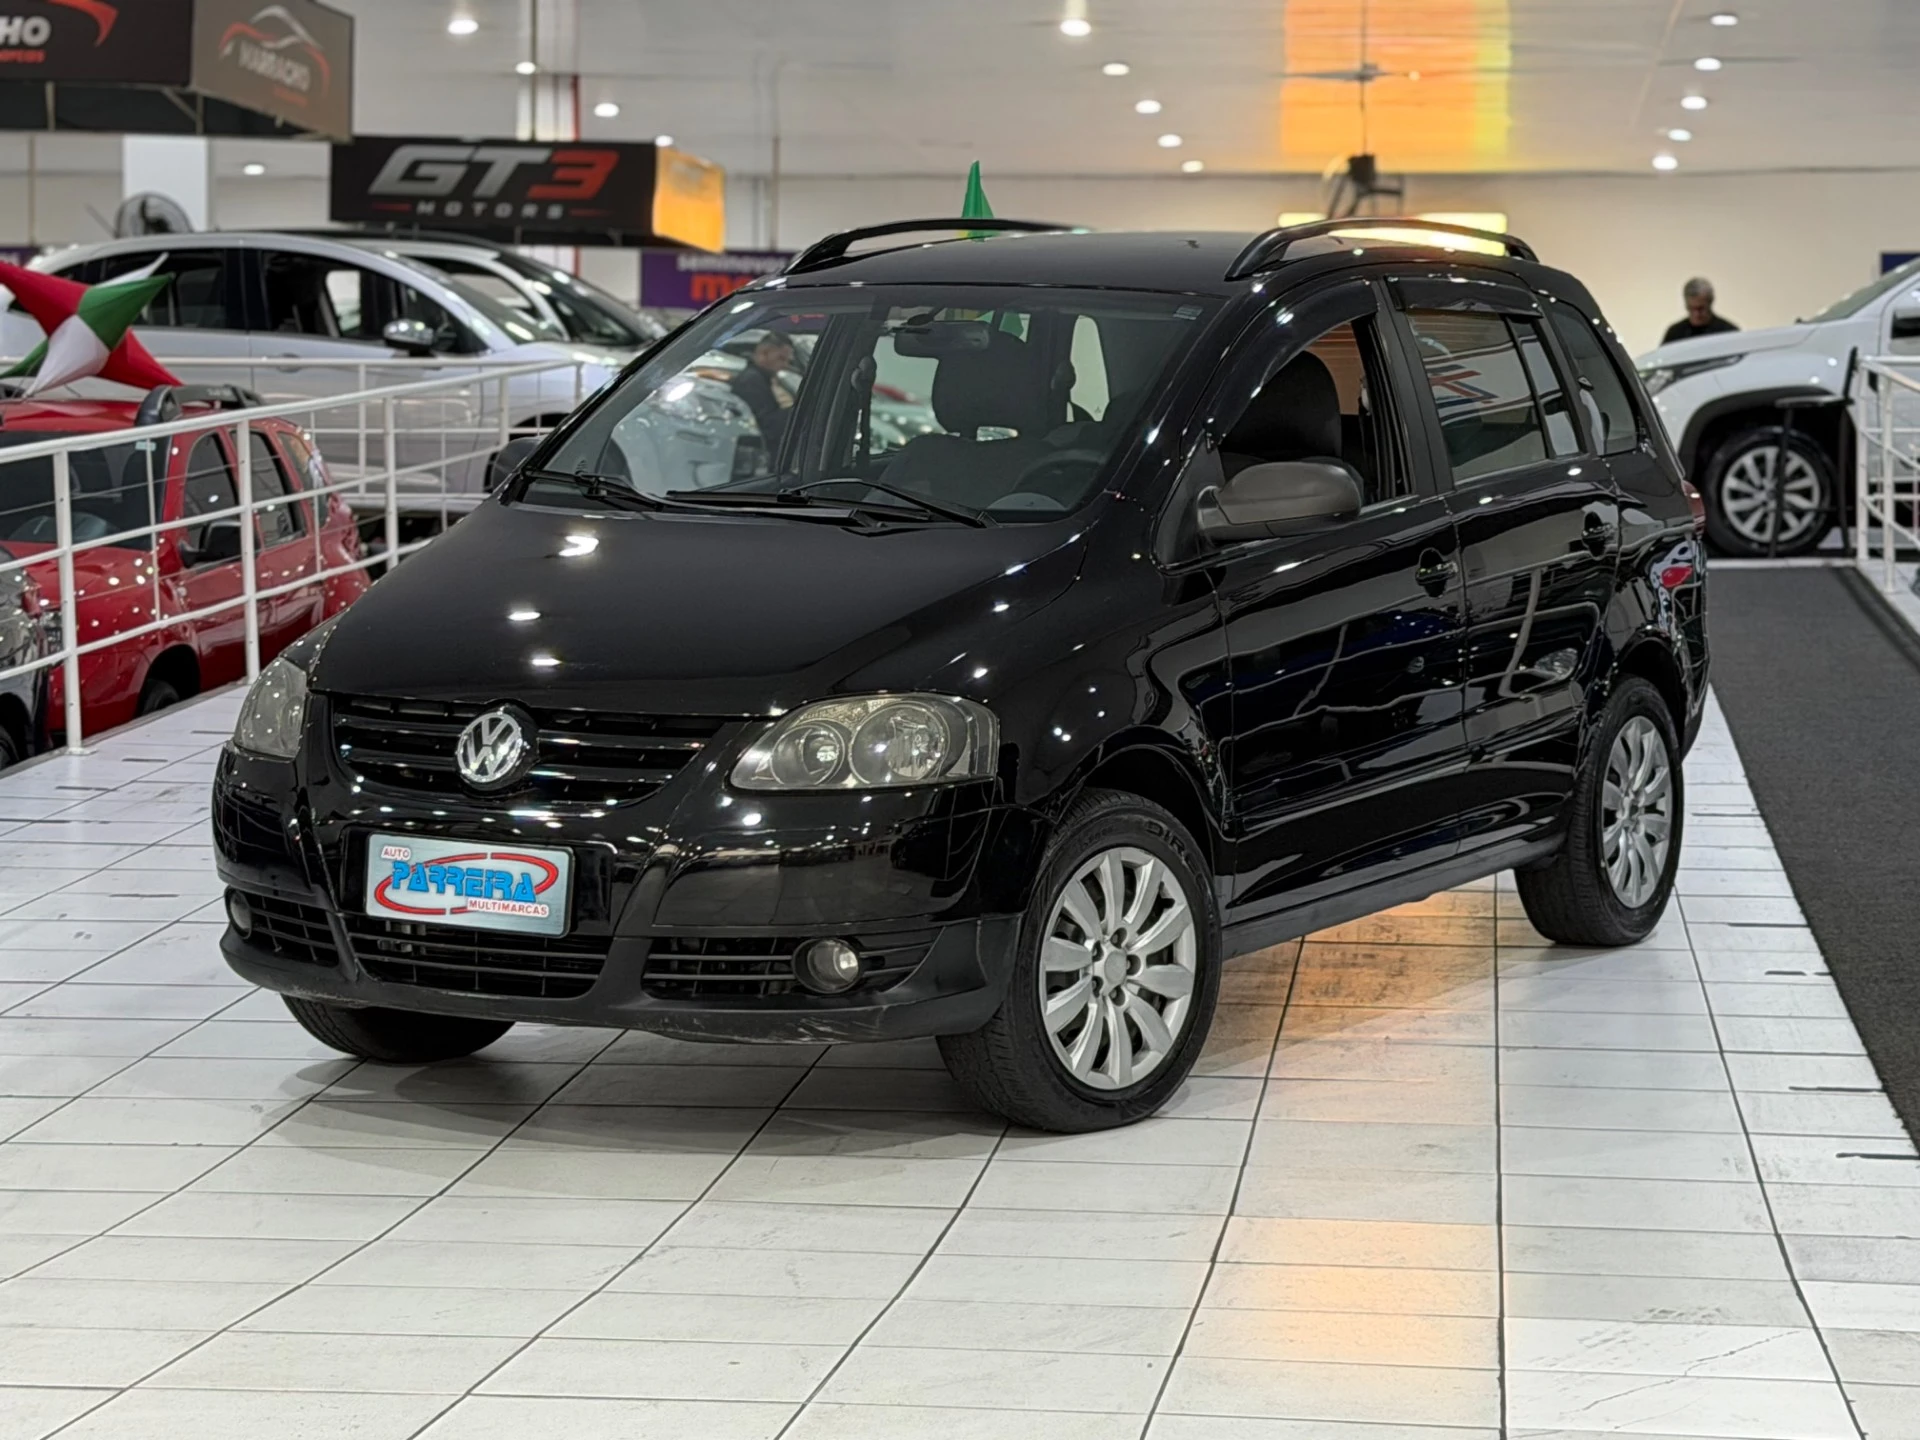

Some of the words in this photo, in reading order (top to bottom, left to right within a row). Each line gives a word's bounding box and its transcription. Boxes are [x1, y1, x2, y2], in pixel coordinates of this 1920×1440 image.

[367, 144, 619, 200] GT3
[415, 200, 564, 219] MOTORS
[383, 847, 410, 860] AUTO
[391, 860, 536, 903] PARREIRA
[468, 900, 548, 916] MULTIMARCAS
